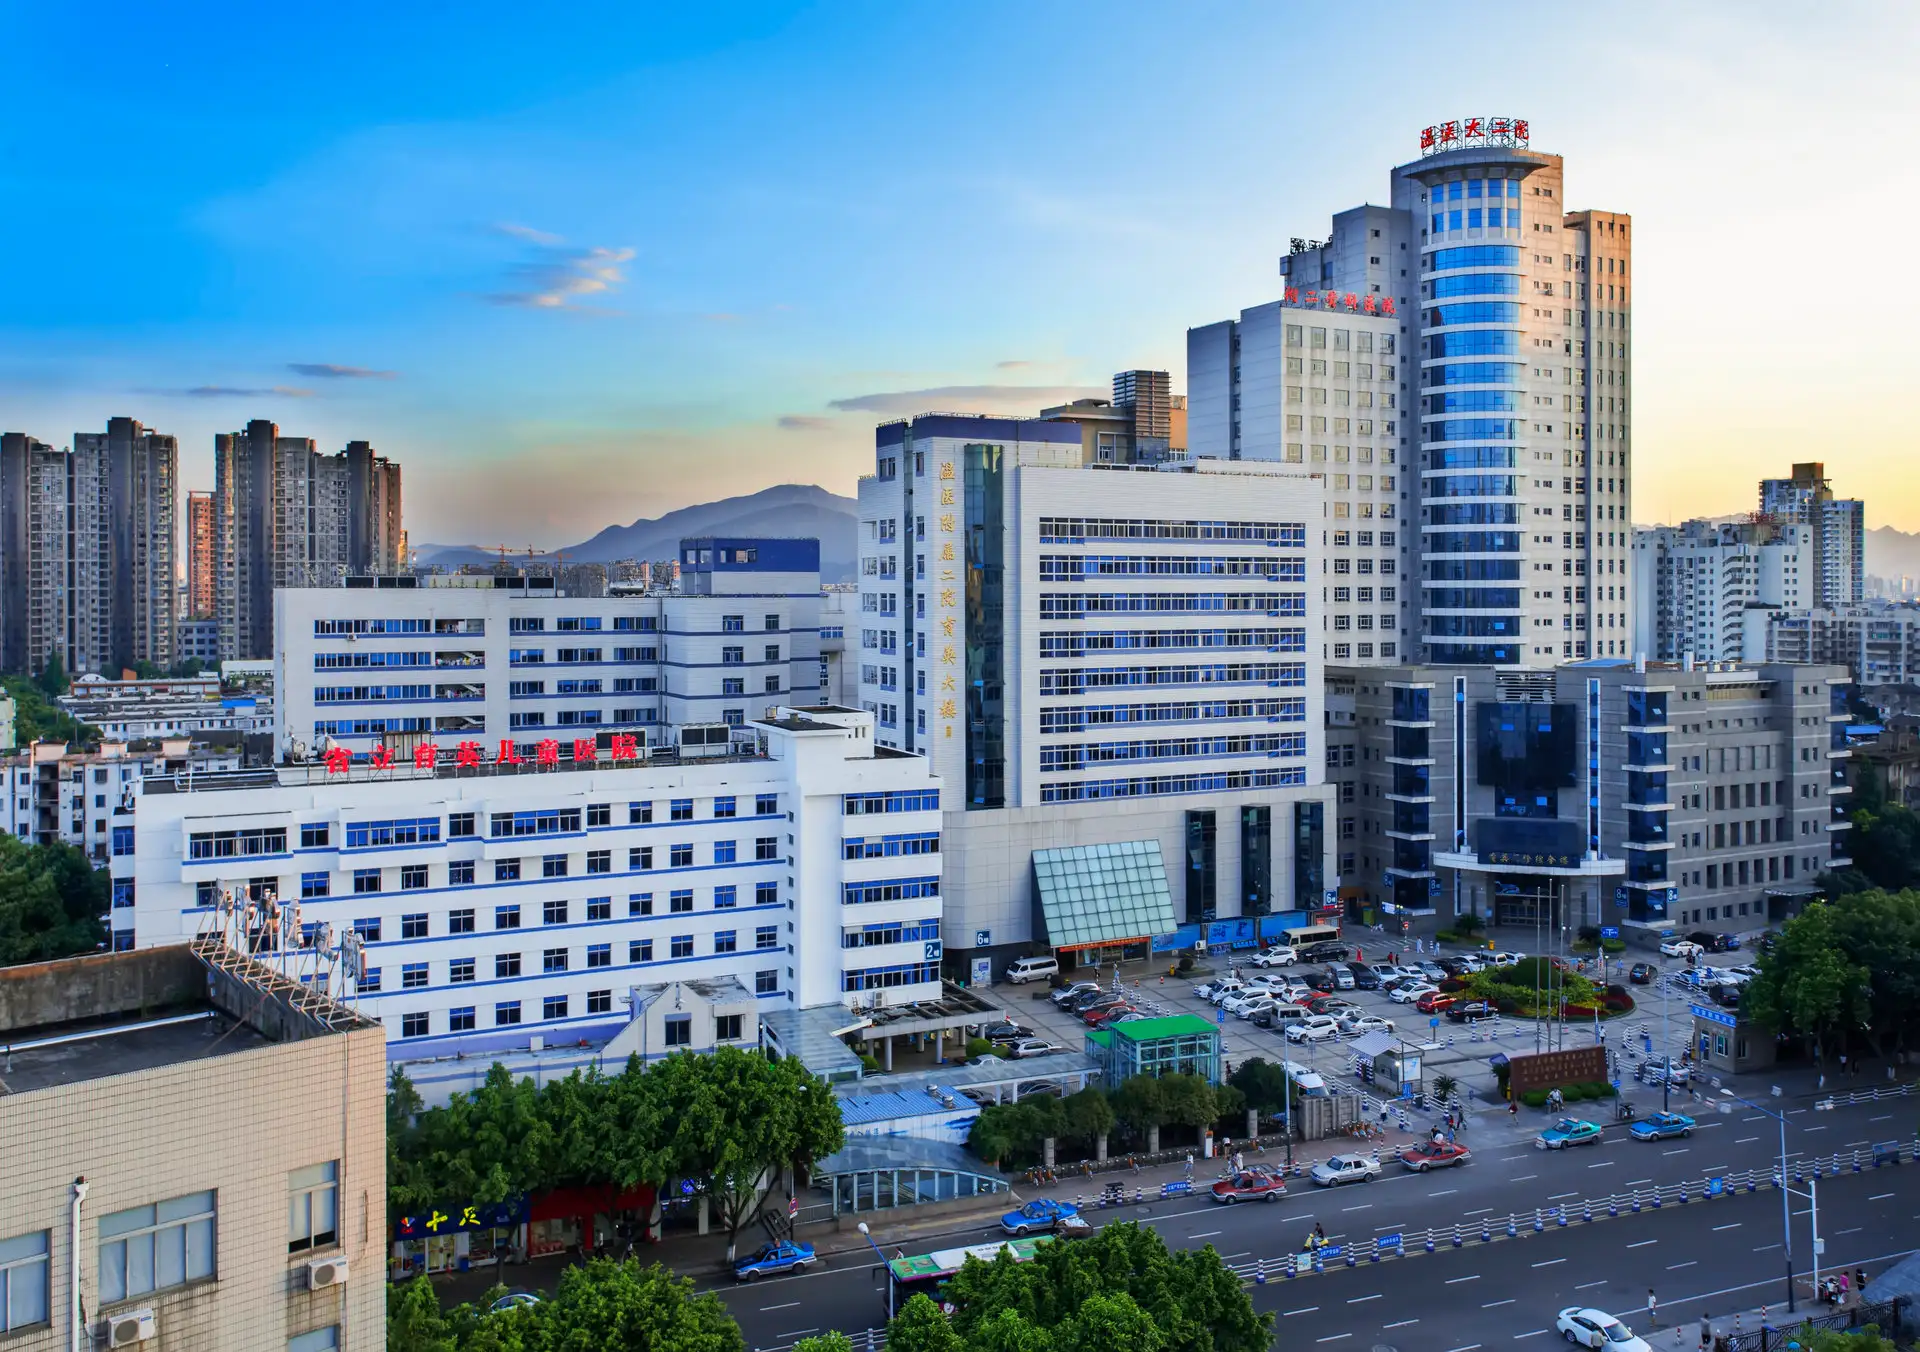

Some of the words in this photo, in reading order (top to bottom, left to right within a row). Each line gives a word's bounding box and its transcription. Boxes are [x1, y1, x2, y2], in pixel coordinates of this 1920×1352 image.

[322, 734, 638, 775] 省立育英儿童医院
